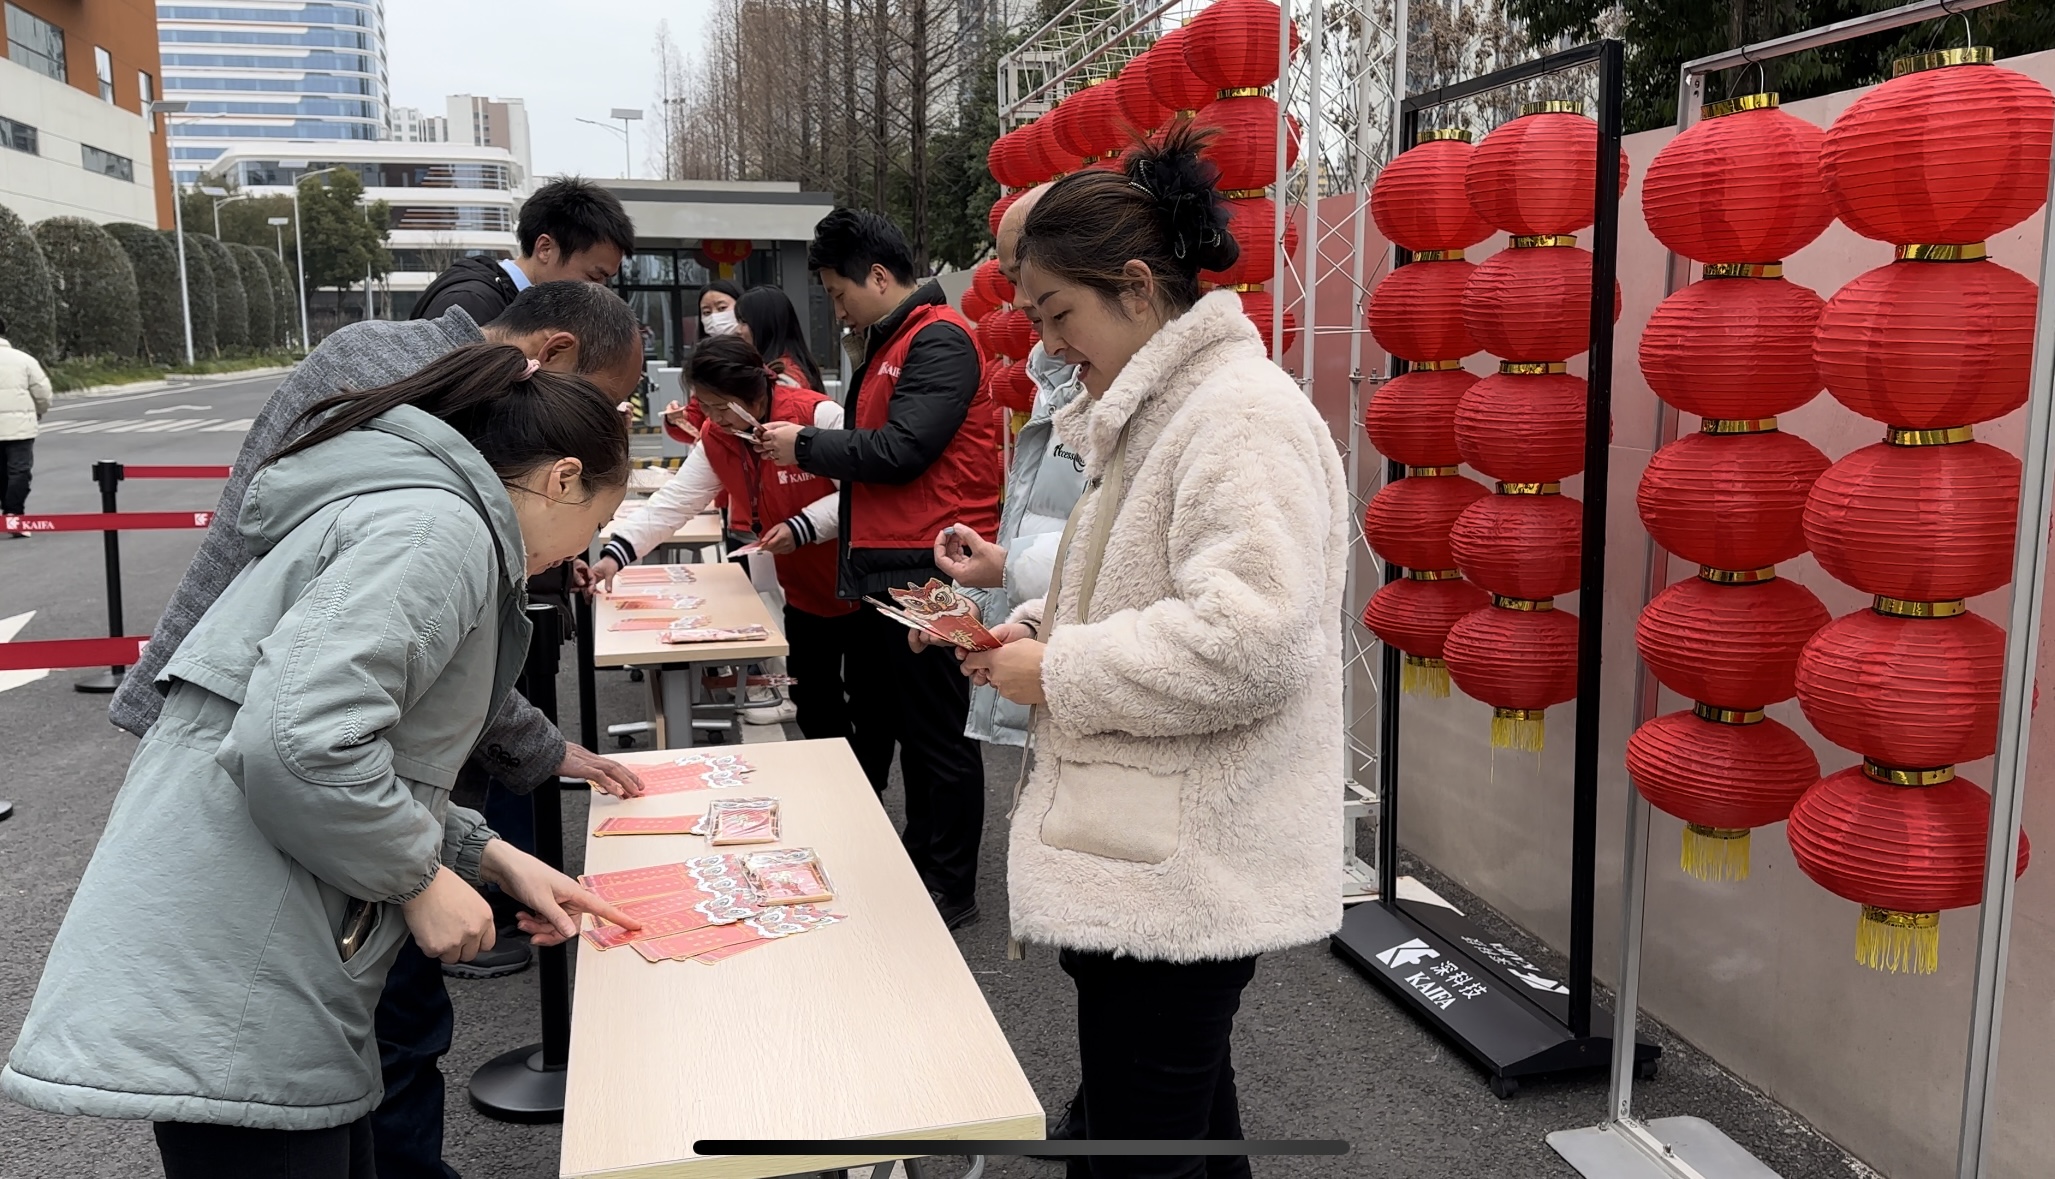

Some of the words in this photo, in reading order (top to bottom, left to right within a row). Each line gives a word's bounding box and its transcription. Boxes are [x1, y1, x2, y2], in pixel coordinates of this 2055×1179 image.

[22, 520, 55, 530] KAIFA
[1404, 971, 1457, 1010] KAIFA
[1430, 960, 1487, 1000] 深科技
